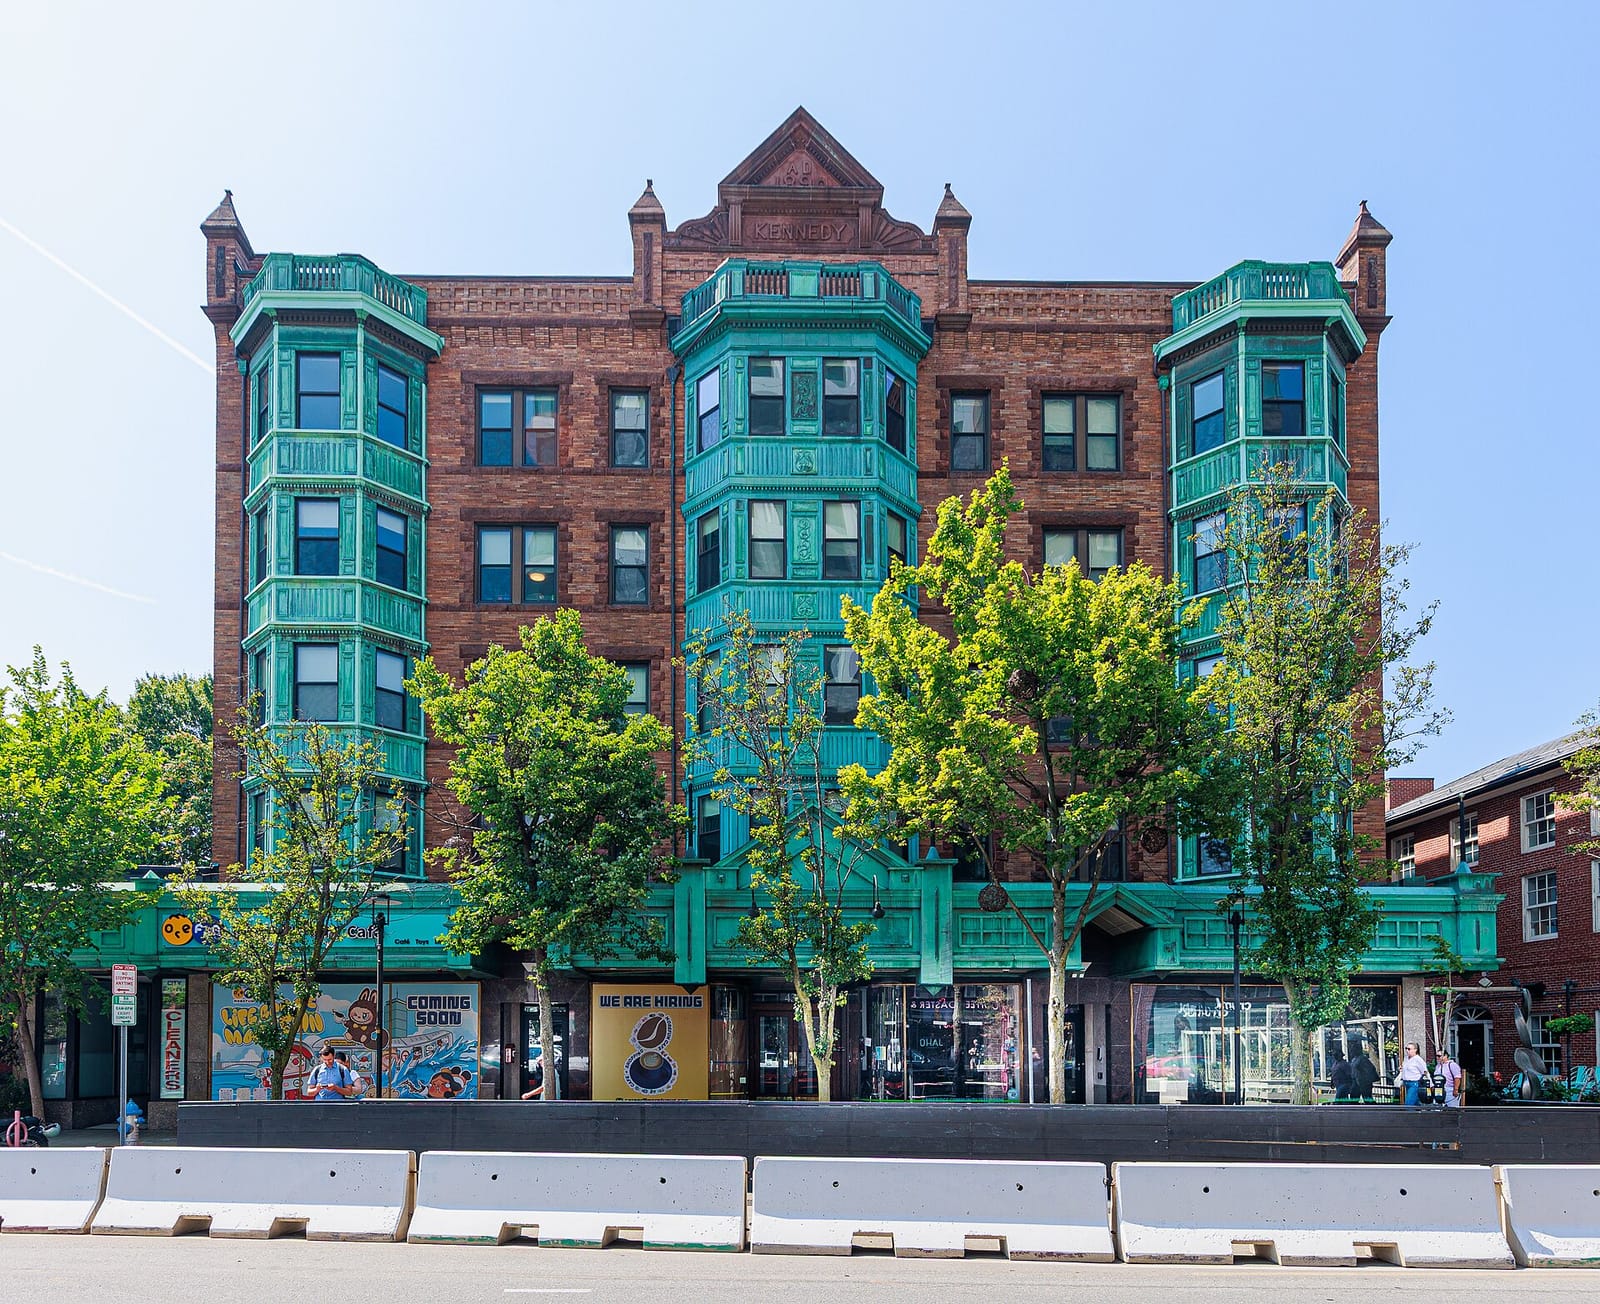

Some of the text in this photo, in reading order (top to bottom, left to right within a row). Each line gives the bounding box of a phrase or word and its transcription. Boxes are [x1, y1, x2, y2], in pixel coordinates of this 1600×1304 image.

[754, 223, 847, 241] KENNEDY
[415, 938, 429, 946] Toys
[407, 995, 471, 1010] COMING
[599, 995, 703, 1008] WE ARE HIRING
[416, 1010, 462, 1025] SOON
[165, 1011, 182, 1091] CLEANERS
